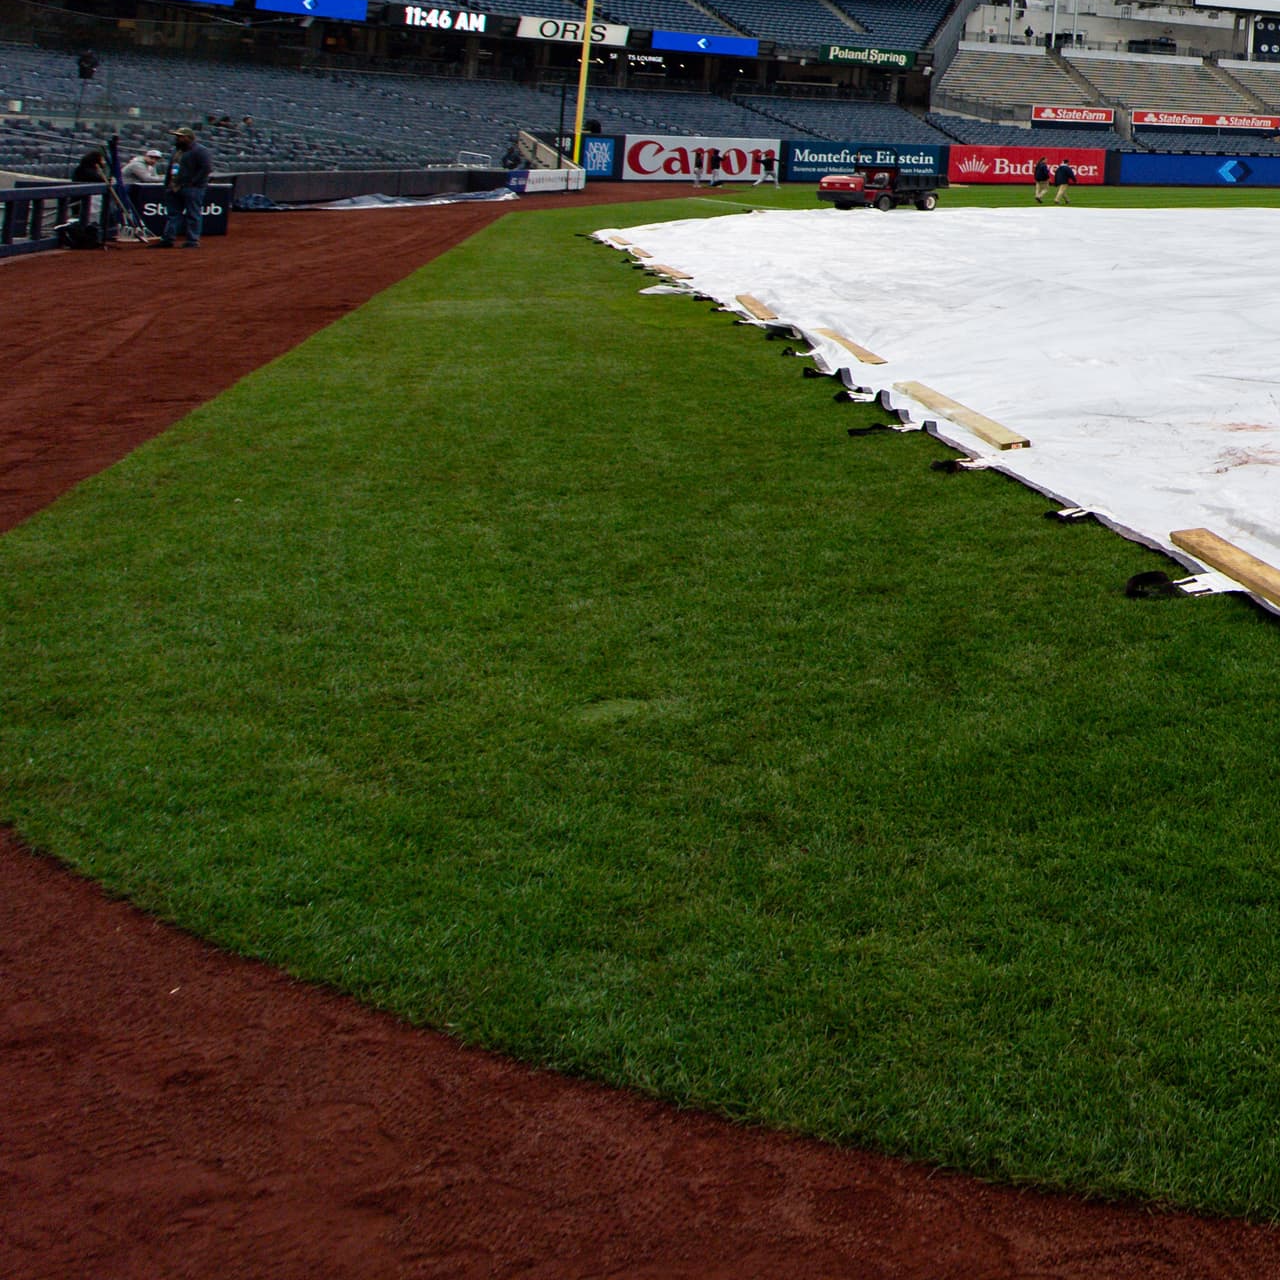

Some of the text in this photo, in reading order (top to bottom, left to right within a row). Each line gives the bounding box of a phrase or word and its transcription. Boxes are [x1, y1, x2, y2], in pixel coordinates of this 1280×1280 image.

[404, 6, 486, 33] 11:46 AM
[637, 54, 664, 62] LOUNGE
[829, 46, 907, 65] Poland Spring
[1056, 109, 1106, 120] State Farm
[1158, 113, 1203, 125] State Farm
[1228, 116, 1271, 127] State Farm
[588, 142, 608, 152] NEW
[585, 151, 611, 162] YORK
[626, 140, 775, 176] Canon
[587, 161, 607, 171] LIFE
